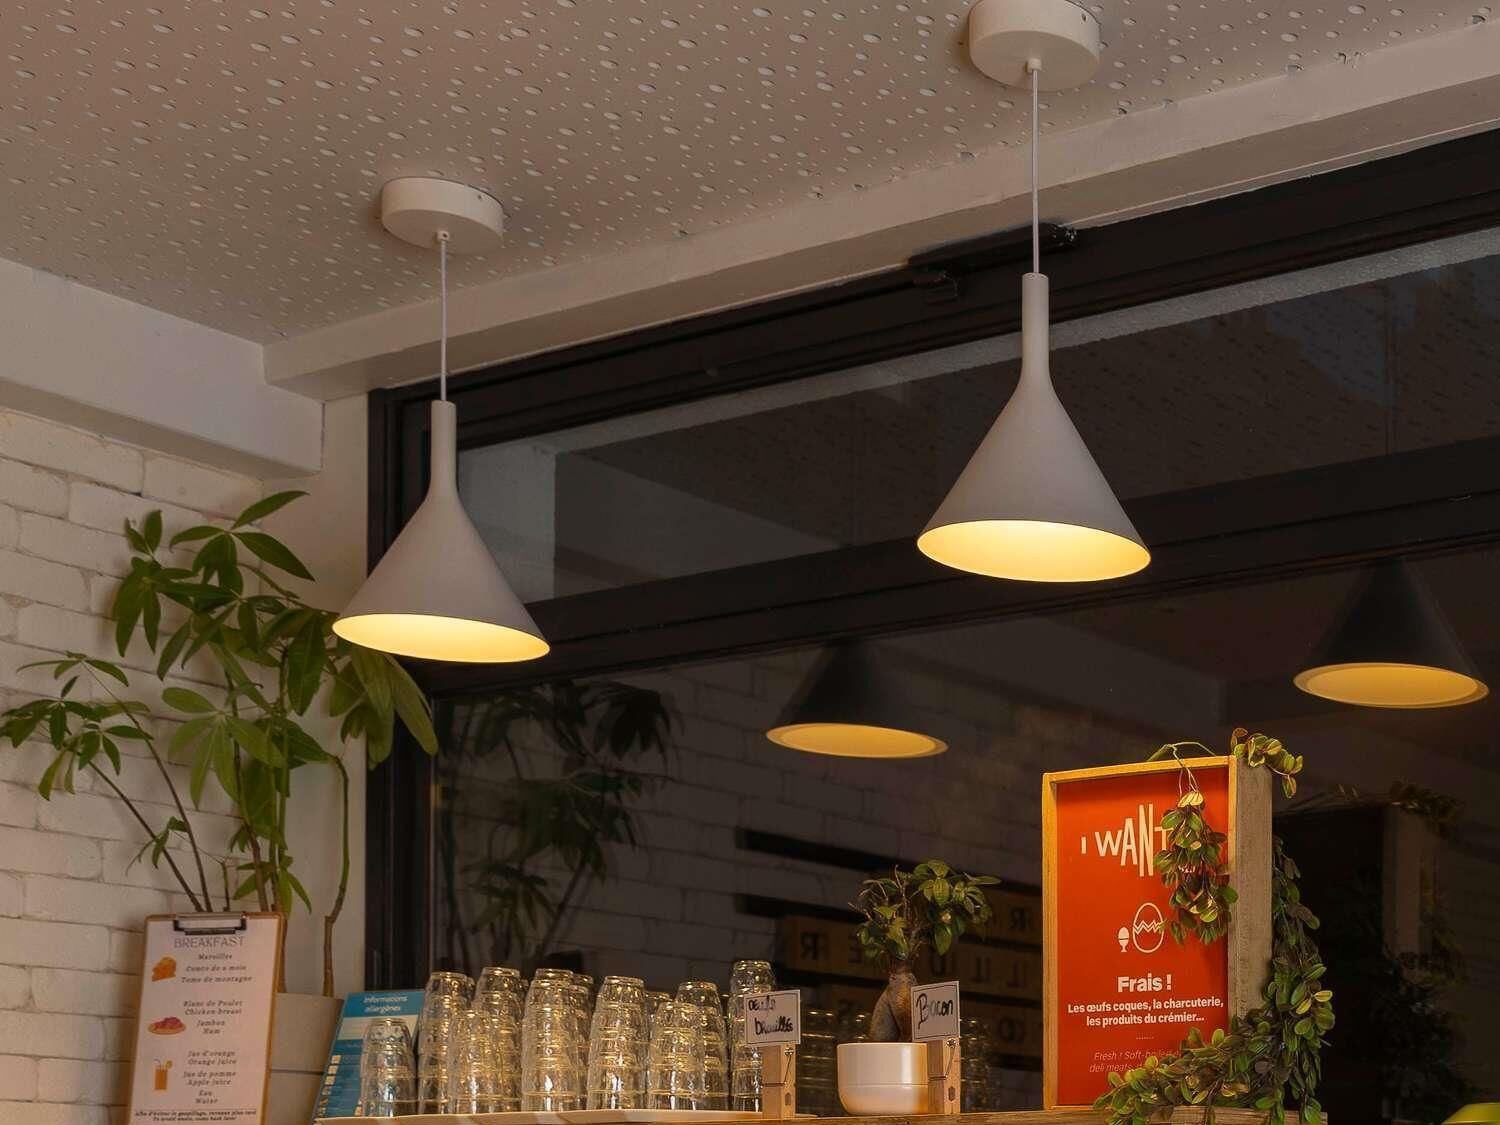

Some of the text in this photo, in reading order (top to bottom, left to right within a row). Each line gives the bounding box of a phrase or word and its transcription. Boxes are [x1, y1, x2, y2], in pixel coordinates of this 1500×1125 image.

[1094, 803, 1174, 878] WANT
[174, 936, 244, 948] BREAKFAST
[1117, 973, 1172, 993] Frais !
[915, 993, 954, 1030] Bacon
[1068, 996, 1224, 1014] Les œufs coques, la charcuterie,
[1086, 1015, 1101, 1027] les
[1102, 1014, 1143, 1028] produits
[1144, 1014, 1157, 1024] du
[1094, 1050, 1117, 1061] Fresh
